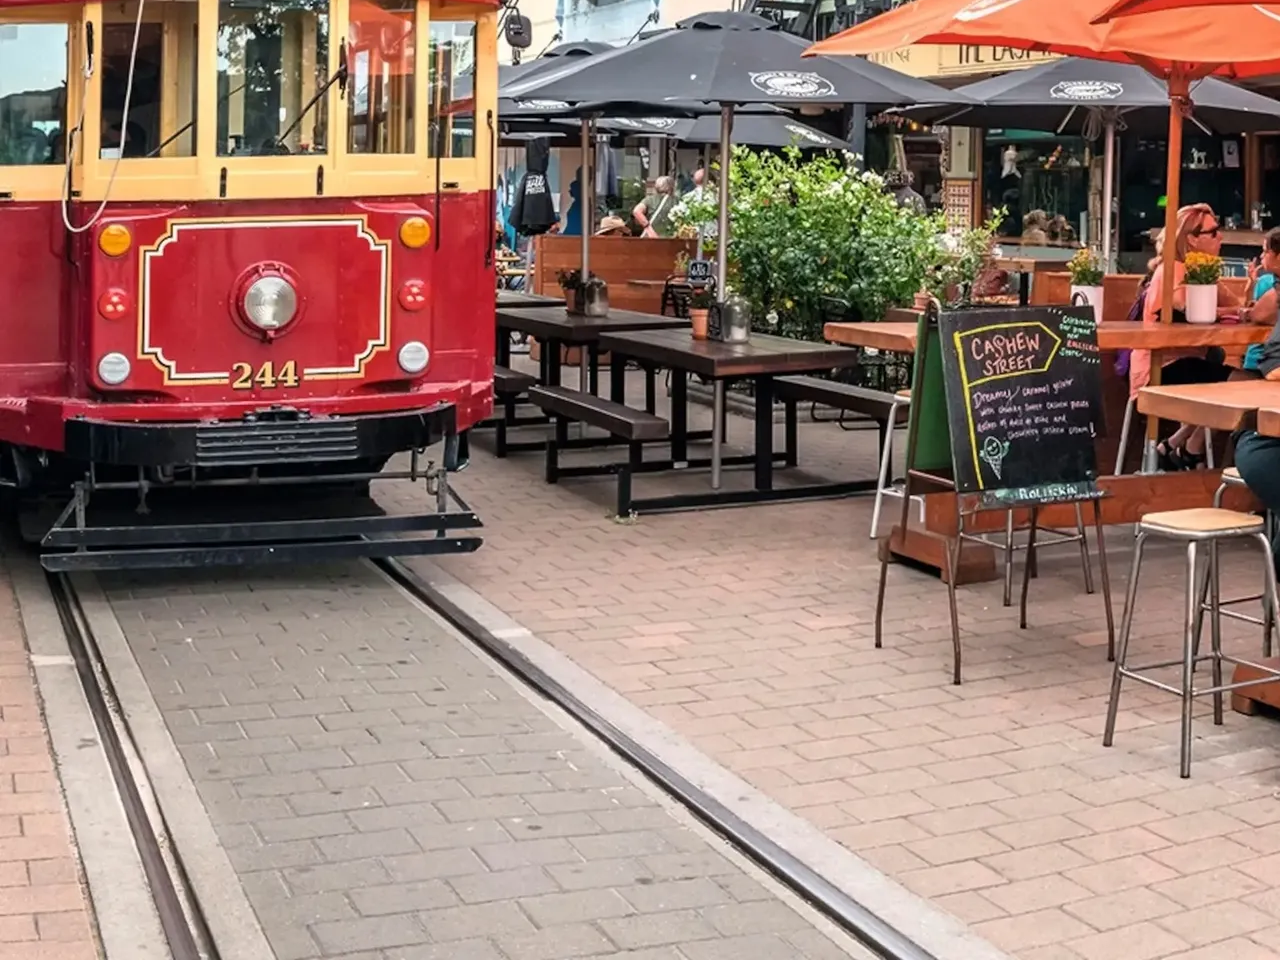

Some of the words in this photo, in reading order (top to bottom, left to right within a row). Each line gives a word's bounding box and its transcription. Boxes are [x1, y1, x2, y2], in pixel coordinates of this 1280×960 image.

[971, 332, 1040, 361] CASHEW
[231, 359, 300, 390] 244
[983, 354, 1035, 376] STREET
